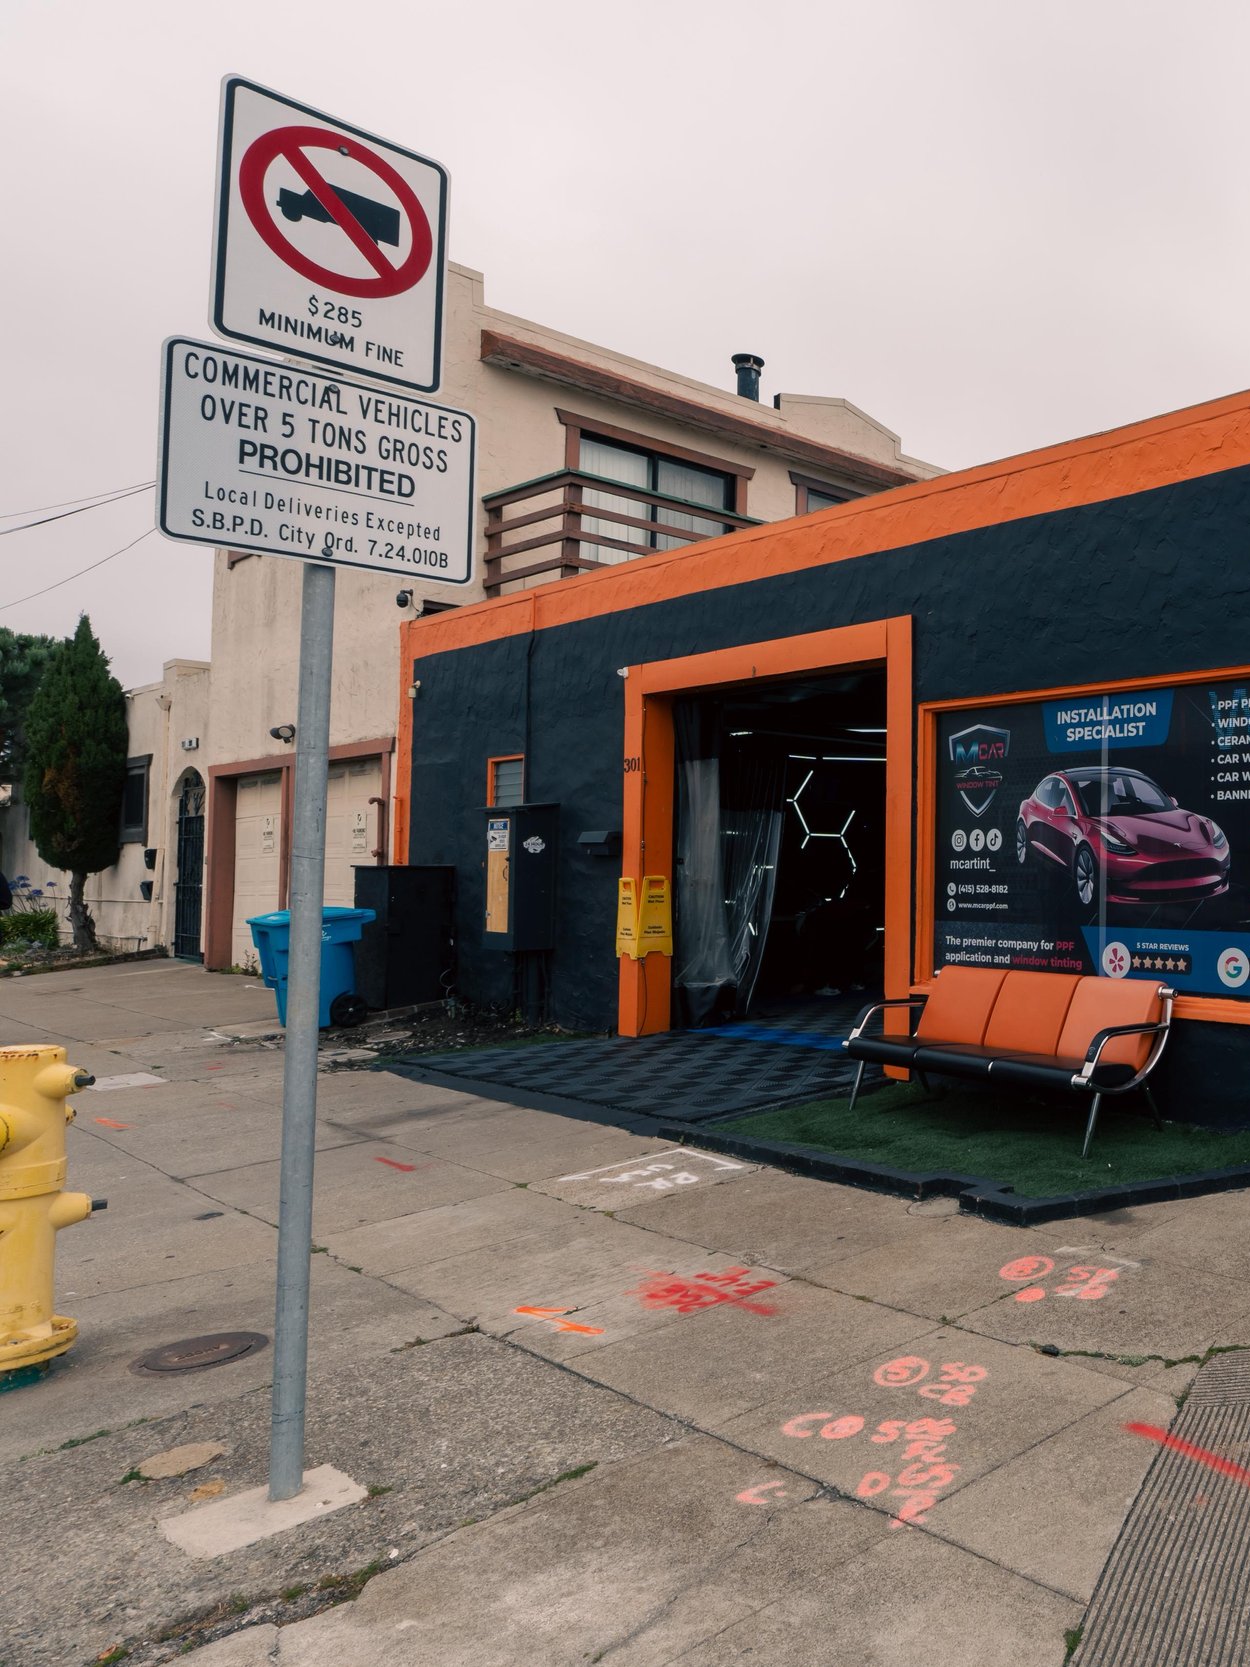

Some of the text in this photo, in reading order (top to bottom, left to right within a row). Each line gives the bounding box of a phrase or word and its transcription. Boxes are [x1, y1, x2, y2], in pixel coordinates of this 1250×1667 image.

[308, 295, 362, 328] $285
[259, 308, 404, 367] MINIMUM FINE
[184, 352, 463, 443] COMMERCIAL VEHICLES
[201, 394, 449, 473] OVER 5 TONS GROSS
[239, 439, 416, 499] PROHIBITED
[205, 481, 441, 542] Local Deliveries Excepted
[192, 509, 449, 569] S.B.P.D. City Ord. 7.24.010B
[1056, 702, 1157, 725] INSTALLATION
[1218, 700, 1239, 710] PPF
[1066, 722, 1146, 741] SPECIALIST
[624, 757, 641, 773] 301
[1217, 754, 1239, 765] CAR
[956, 779, 999, 790] WINDOW TINT
[1217, 772, 1239, 782] CAR
[950, 857, 996, 872] mcartint_
[958, 883, 1008, 895] (415) 528-8182
[945, 935, 1075, 953] The premier company for PPF
[1136, 942, 1189, 952] 5 STAR REVIEWS
[945, 950, 1082, 970] application and window tinting
